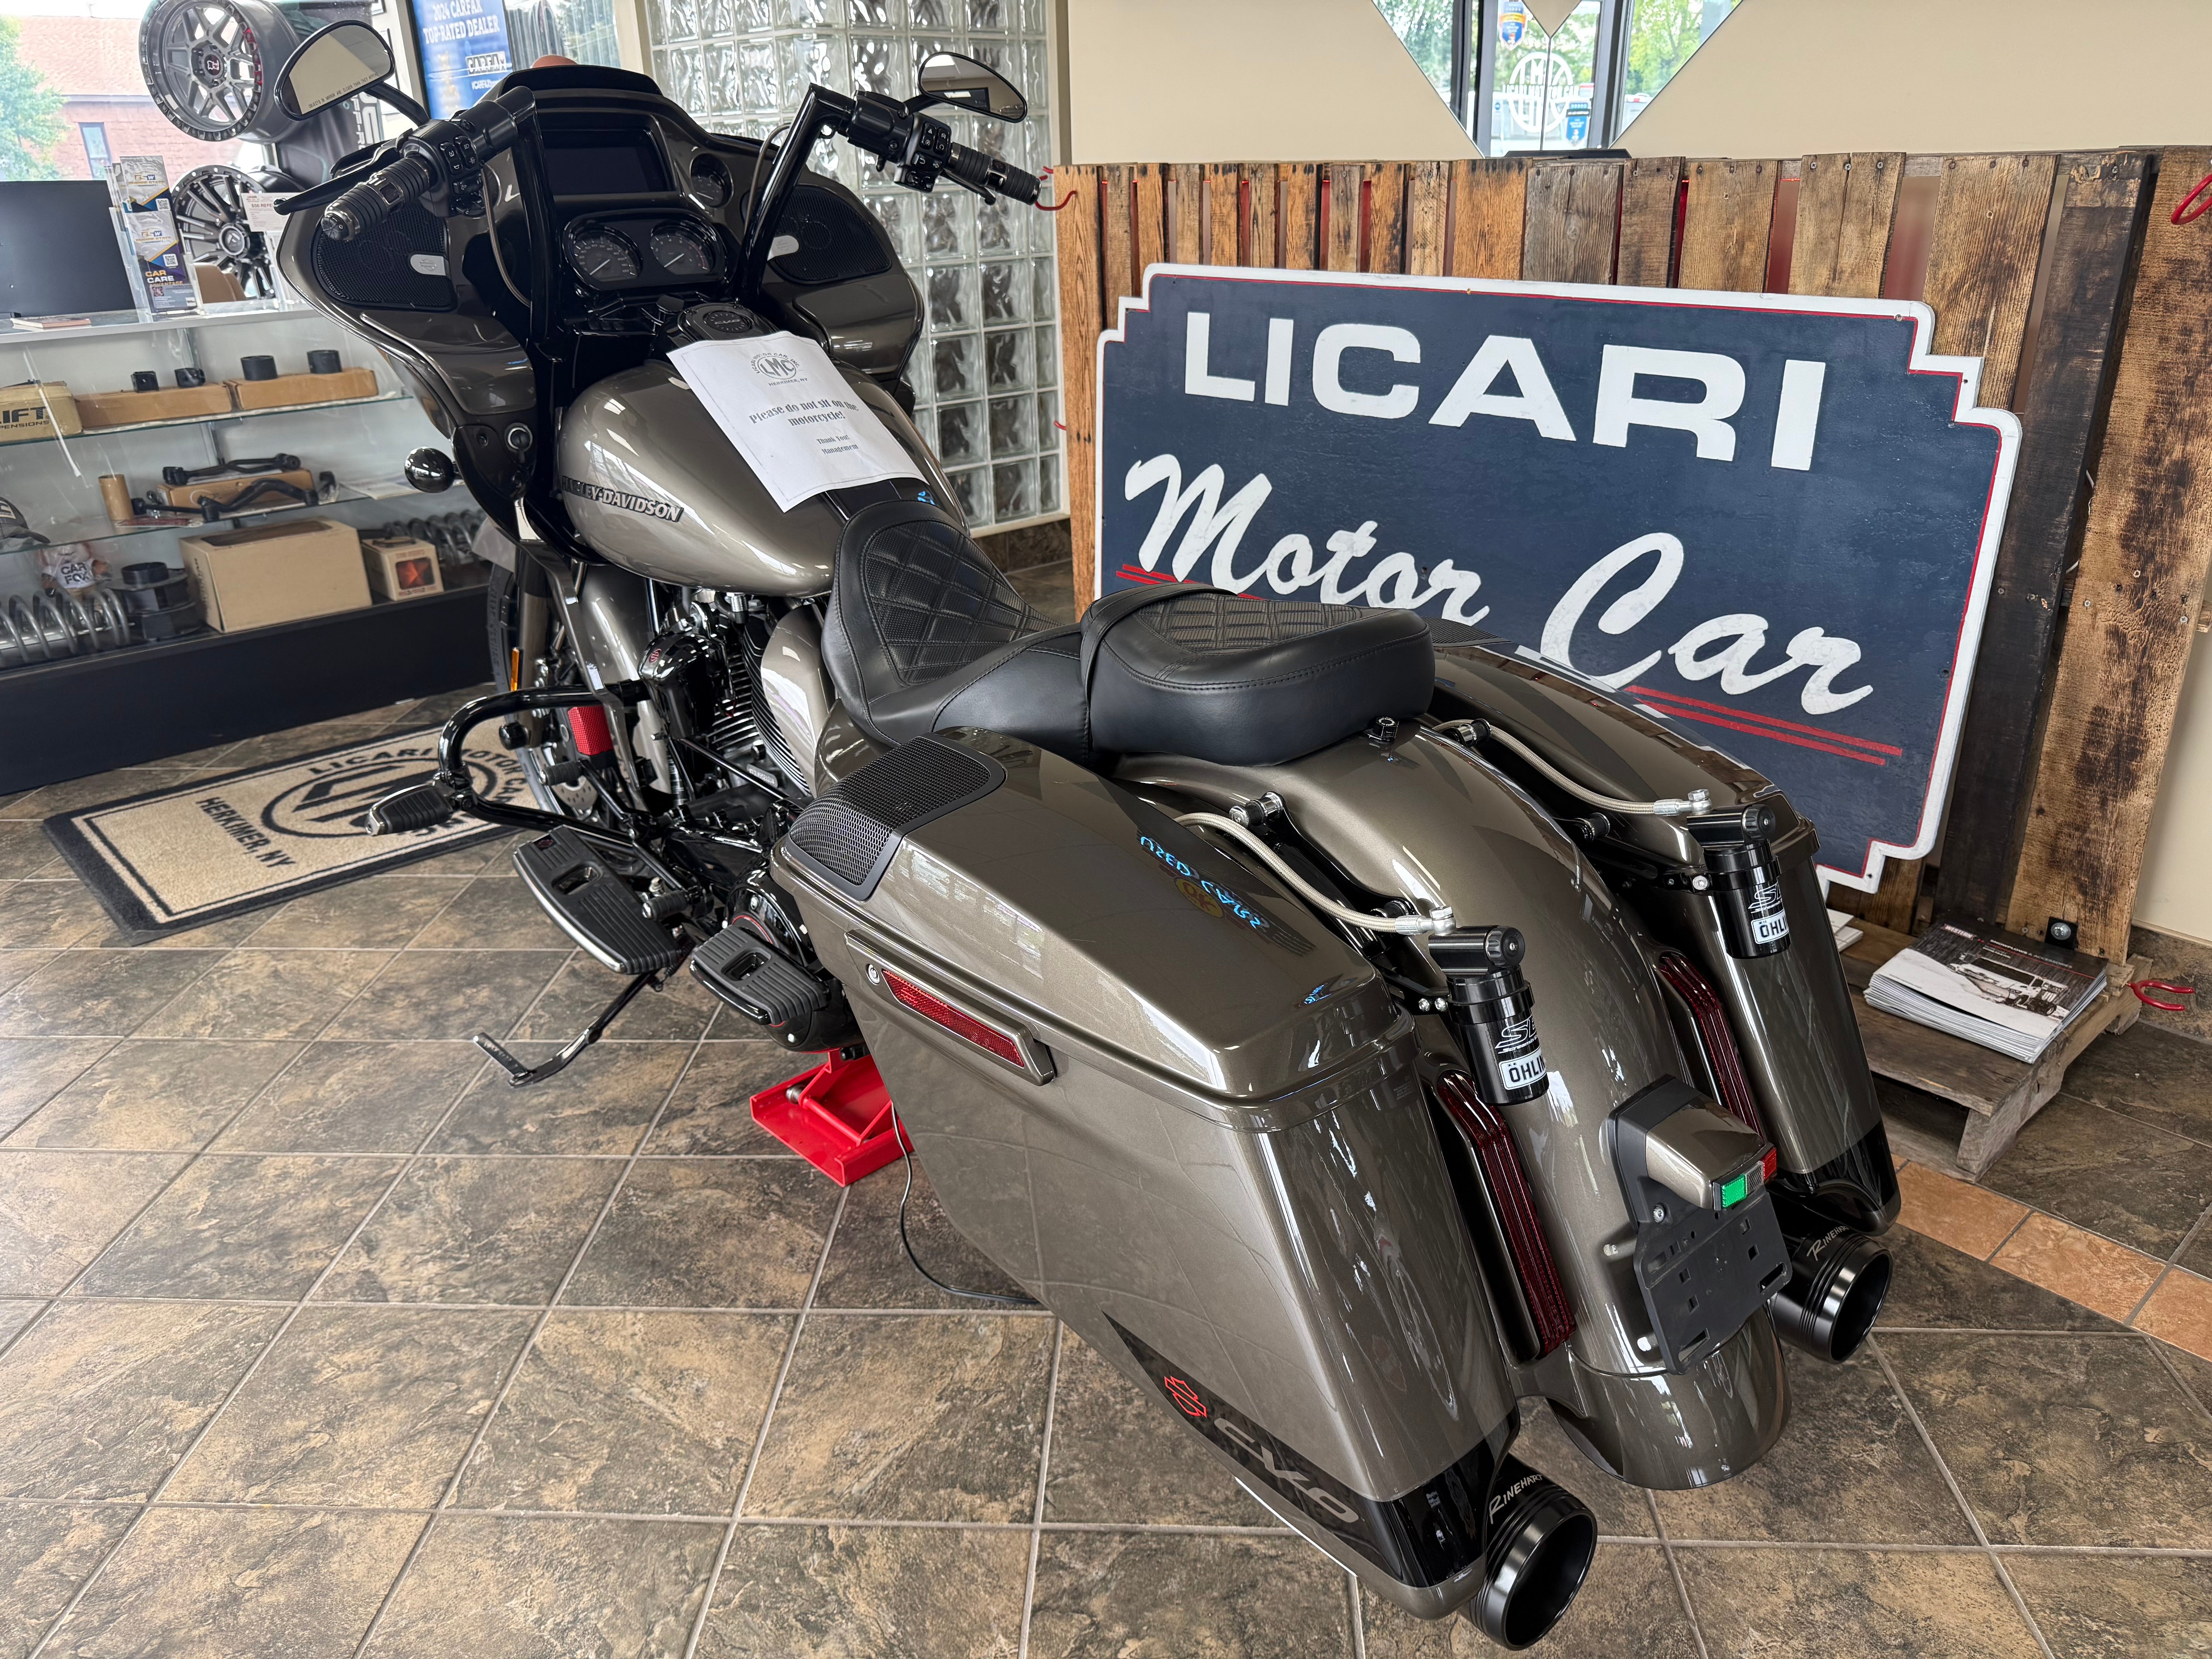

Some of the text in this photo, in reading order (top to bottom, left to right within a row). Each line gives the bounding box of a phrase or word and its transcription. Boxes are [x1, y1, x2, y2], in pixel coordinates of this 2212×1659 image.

[433, 0, 483, 21] 2024 CARFAX
[423, 15, 500, 45] TOP-RATED DEALER
[467, 53, 507, 75] CARFAX
[147, 275, 175, 283] CARE
[760, 358, 794, 376] LMC
[1185, 311, 1826, 472] LICARI
[0, 405, 48, 424] IFT
[749, 406, 785, 424] Please
[785, 404, 800, 412] do
[800, 400, 817, 410] not
[817, 399, 832, 408] sit
[844, 401, 859, 411] the
[788, 410, 846, 426] motorcycle!
[821, 444, 859, 455] Management
[60, 563, 87, 575] CAR
[64, 571, 90, 584] FOX
[1125, 453, 1873, 715] Motor Car
[309, 748, 433, 774] LICARI
[462, 749, 523, 775] OTOR
[195, 796, 296, 867] HERKIMER, NY
[1758, 915, 1788, 938] ÖHLI
[1806, 1226, 1850, 1261] RINEHART
[1214, 1417, 1359, 1523] CVO
[1489, 1474, 1543, 1525] RINEHART
